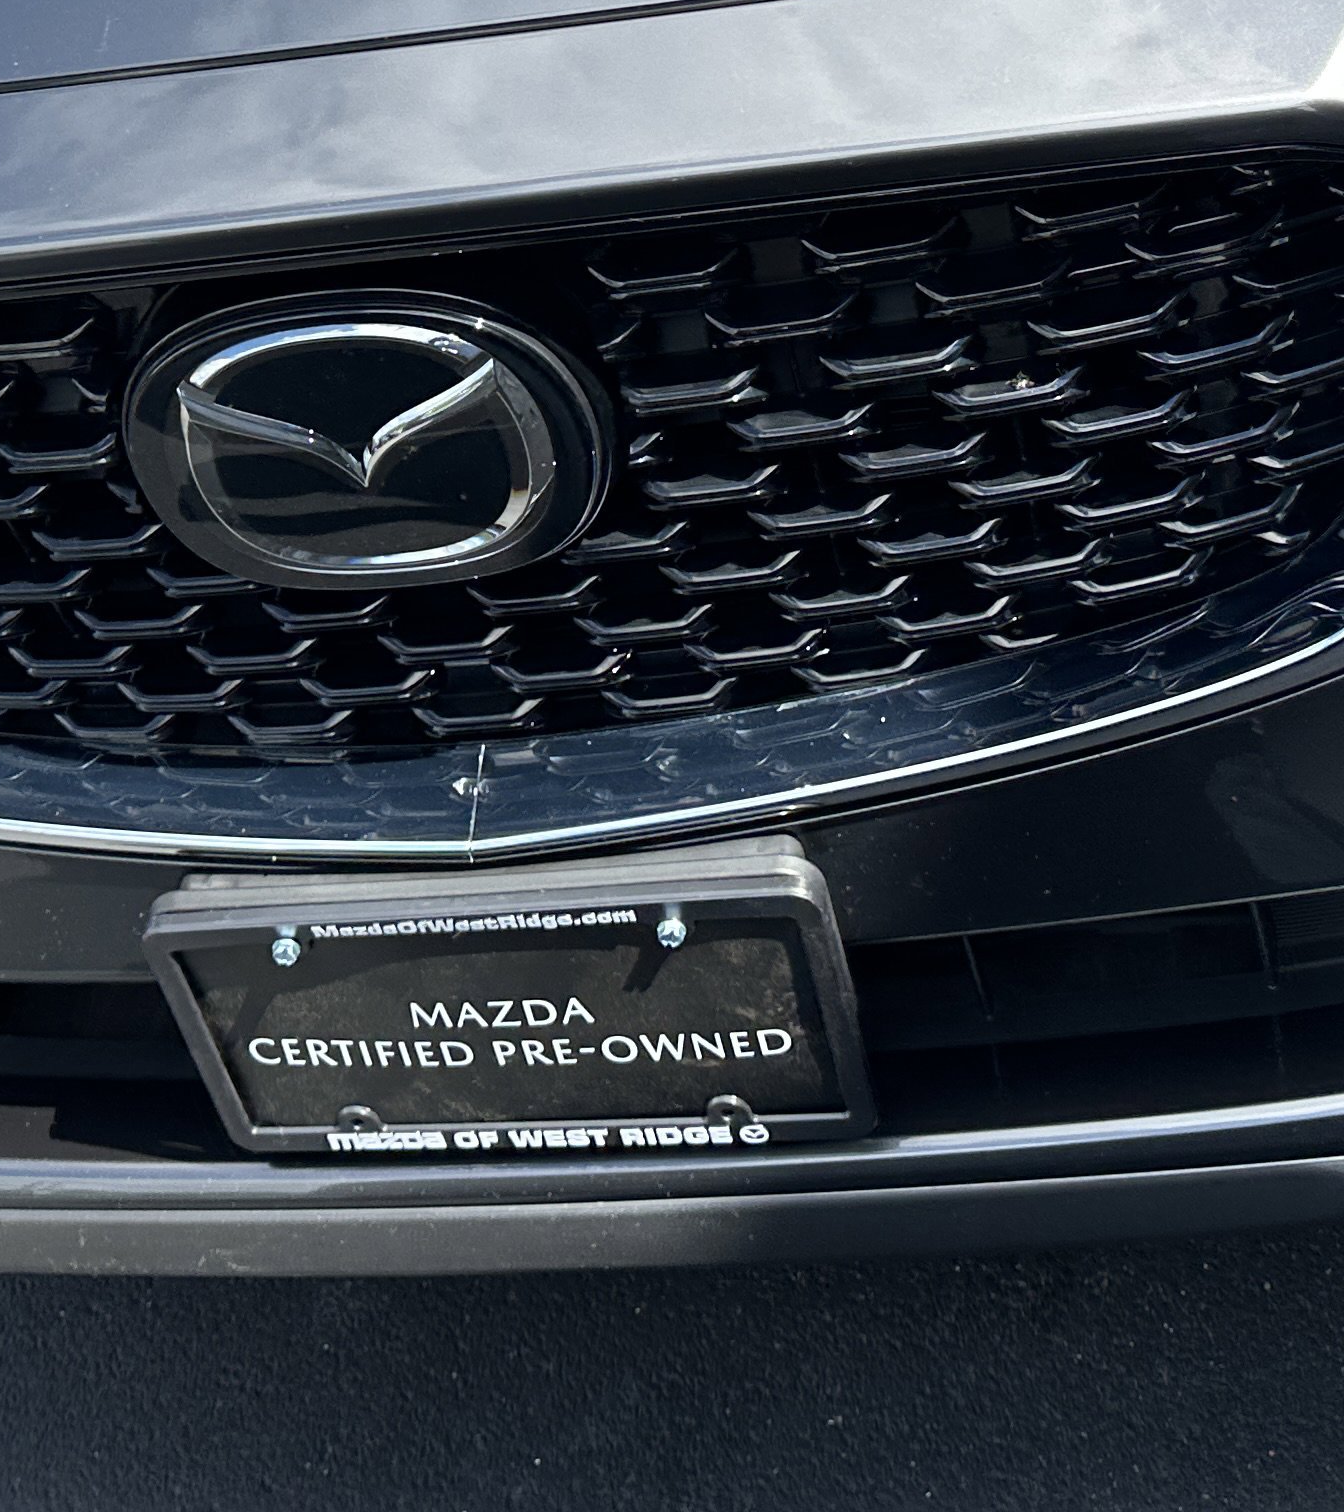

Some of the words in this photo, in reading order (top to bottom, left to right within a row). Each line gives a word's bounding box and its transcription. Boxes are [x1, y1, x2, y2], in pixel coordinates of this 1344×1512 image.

[310, 909, 637, 938] MazdaOfWestRidge.com
[408, 996, 596, 1029] MAZDA
[247, 1036, 475, 1067] CERTIFIED
[491, 1027, 793, 1067] PRE-OWNED
[453, 1129, 499, 1150] OF
[507, 1127, 609, 1150] WEST
[619, 1125, 734, 1147] RIDGE
